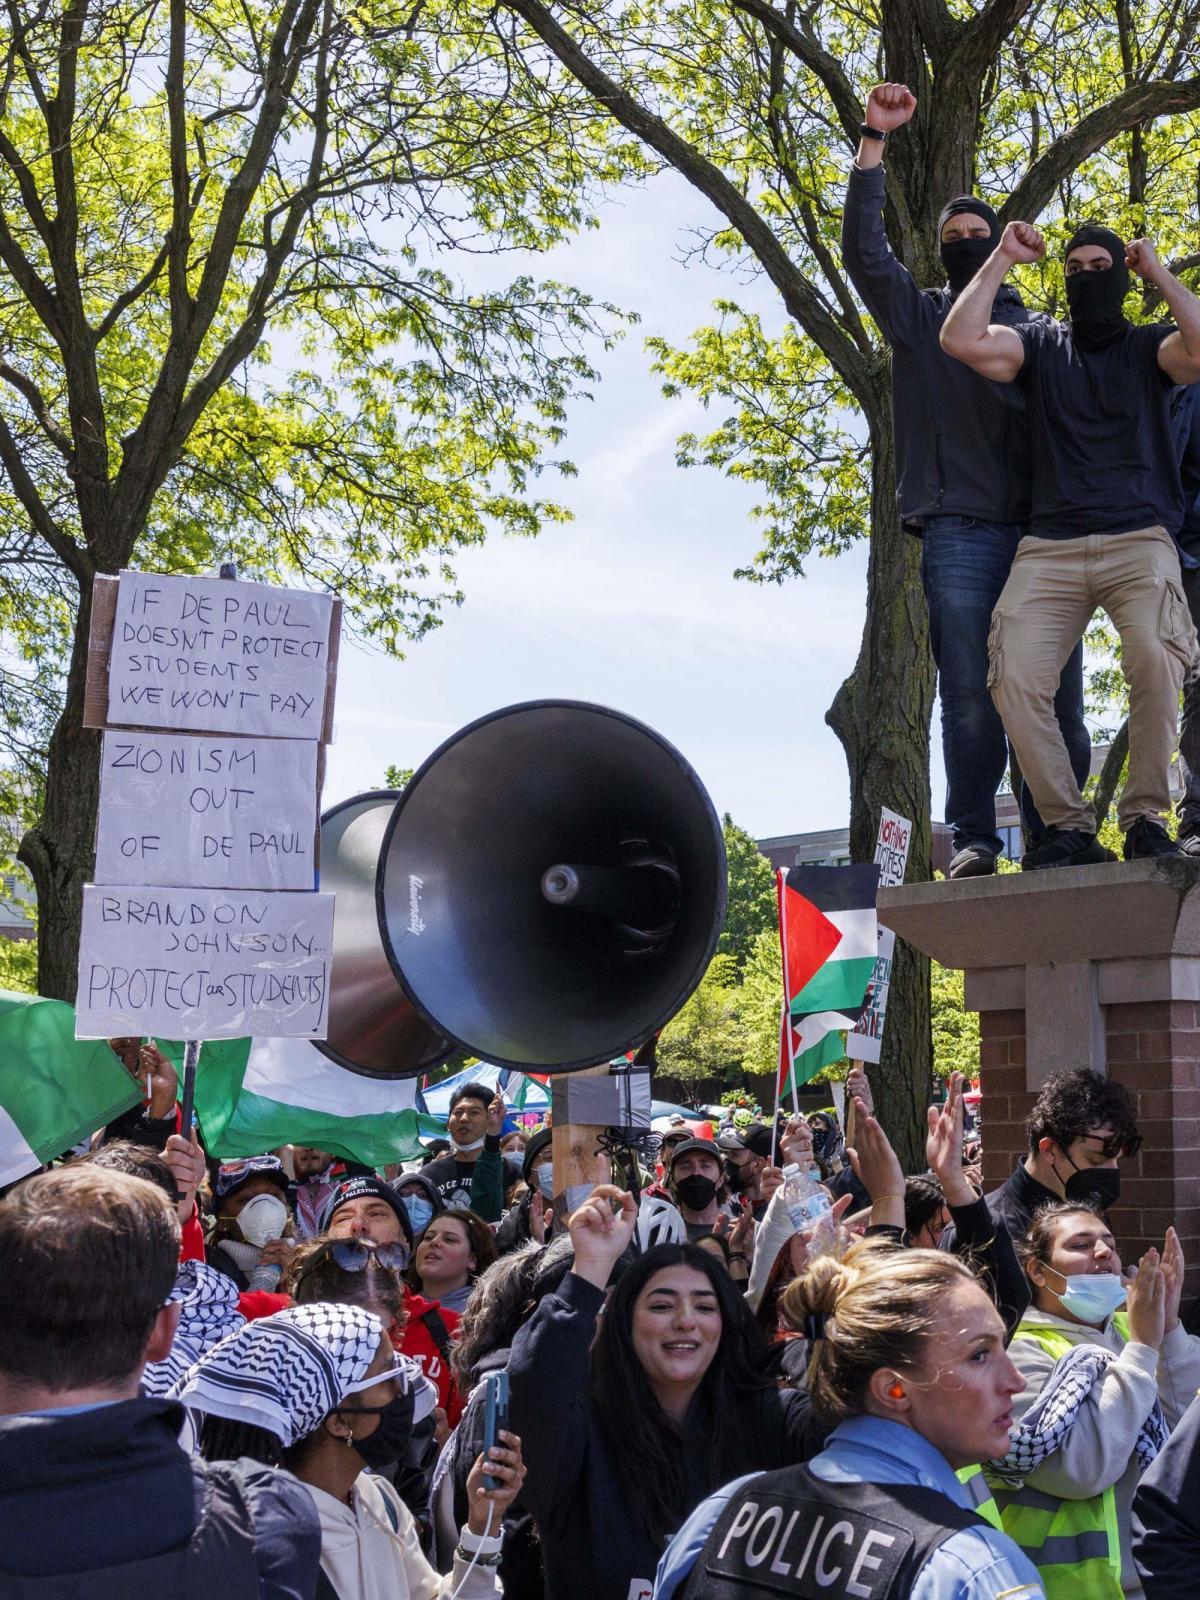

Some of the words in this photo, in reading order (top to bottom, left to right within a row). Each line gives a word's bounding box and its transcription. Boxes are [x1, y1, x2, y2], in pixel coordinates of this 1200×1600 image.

[131, 588, 161, 615] IF
[223, 597, 311, 628] PAUL
[123, 621, 214, 652] DOESN'T
[221, 629, 324, 659] PROTECT
[128, 655, 260, 681] STUDENTS
[120, 686, 164, 705] WE
[170, 689, 260, 709] WON'T
[269, 692, 315, 718] PAY
[111, 743, 257, 775] ZIONISM
[189, 787, 255, 813] OUT
[120, 835, 161, 859] OF
[249, 832, 305, 855] PAUL
[879, 817, 908, 852] NOTHING
[102, 897, 268, 926] BRANDON
[88, 964, 211, 1010] PROTECT
[717, 1501, 895, 1599] POLICE
